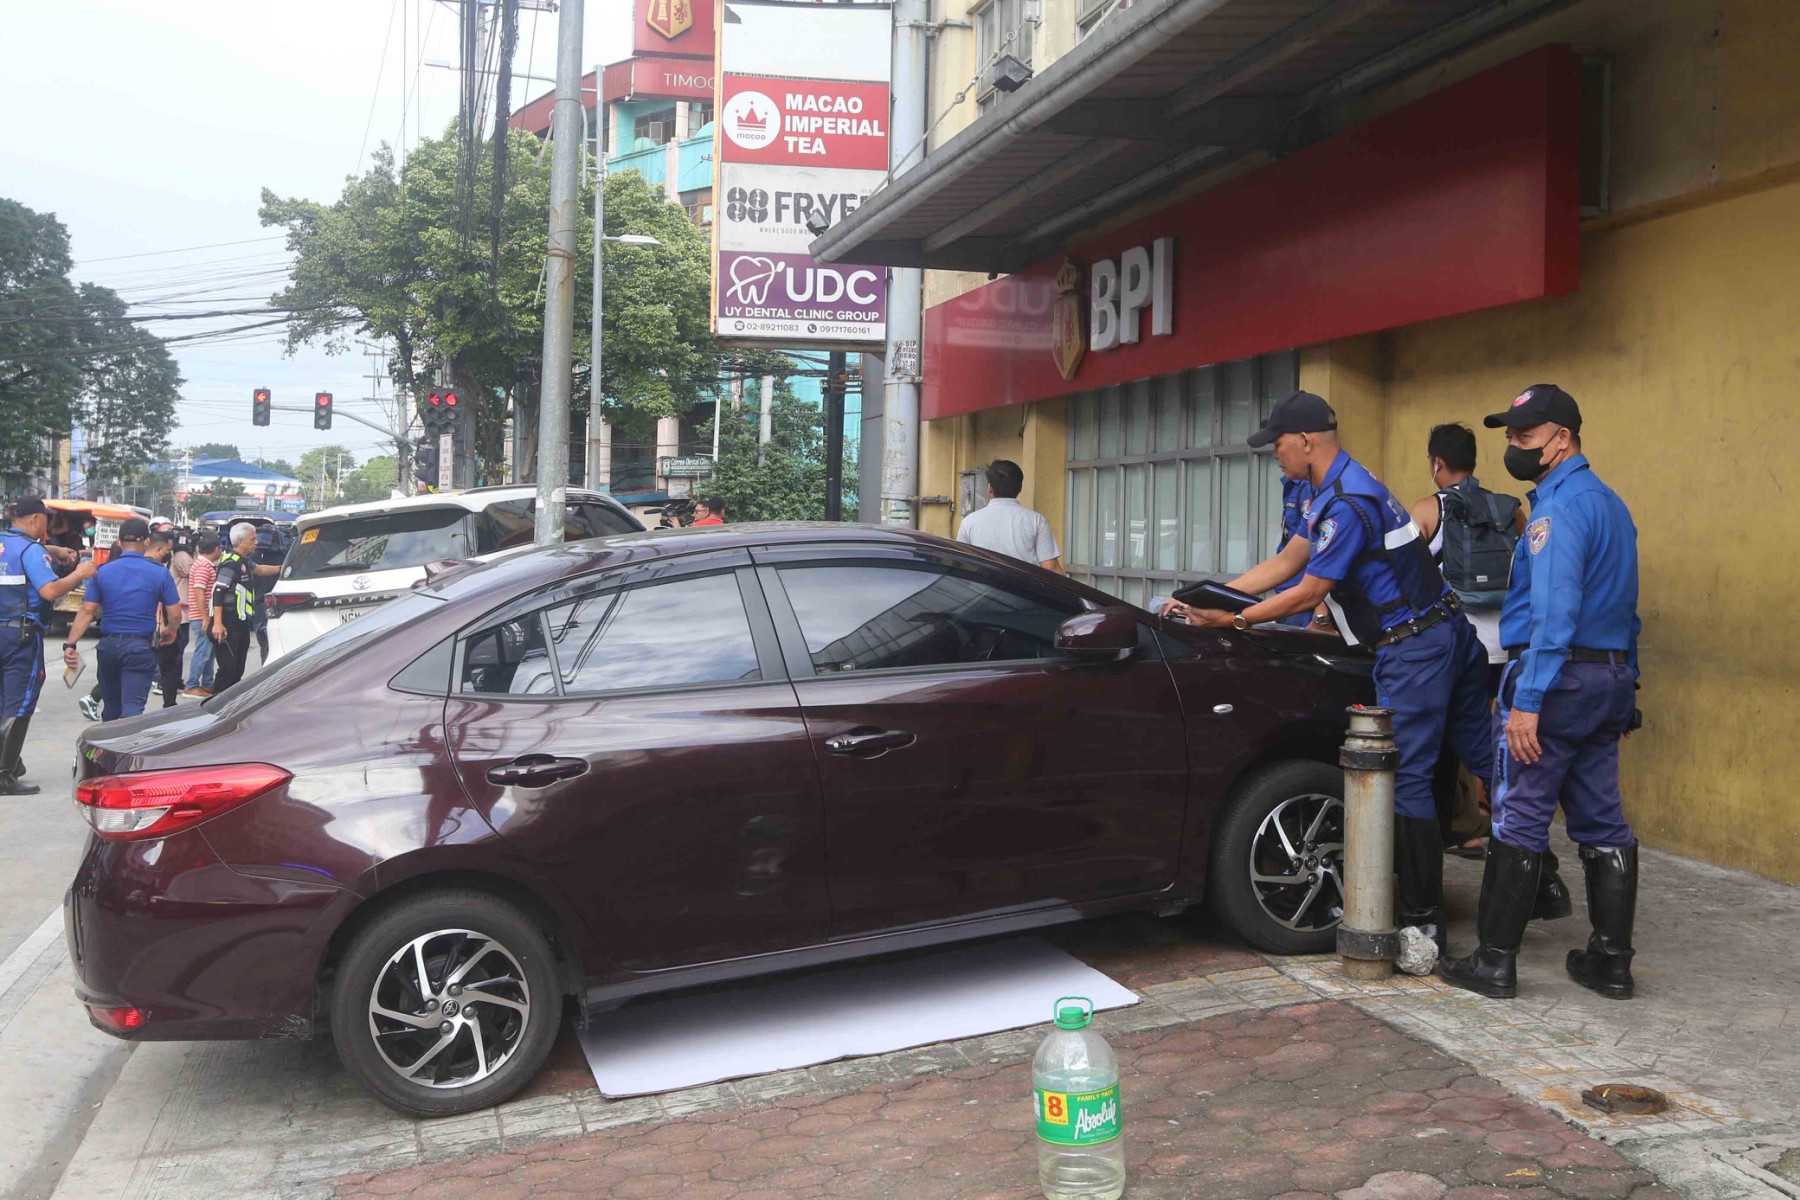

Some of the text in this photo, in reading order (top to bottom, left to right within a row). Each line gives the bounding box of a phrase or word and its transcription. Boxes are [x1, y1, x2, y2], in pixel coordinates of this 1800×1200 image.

[785, 93, 863, 113] MACAO
[783, 115, 885, 136] IMPERIAL
[736, 132, 766, 140] macao
[784, 136, 826, 154] TEA
[786, 267, 878, 305] UDC
[1090, 237, 1174, 351] BPI
[725, 306, 880, 322] UY DENTAL CLINIC GROUP
[746, 323, 871, 334] 02-89211083 09171760161
[1048, 1095, 1063, 1117] 8
[1077, 1093, 1100, 1102] FAMILY
[1074, 1097, 1117, 1140] Absolute
